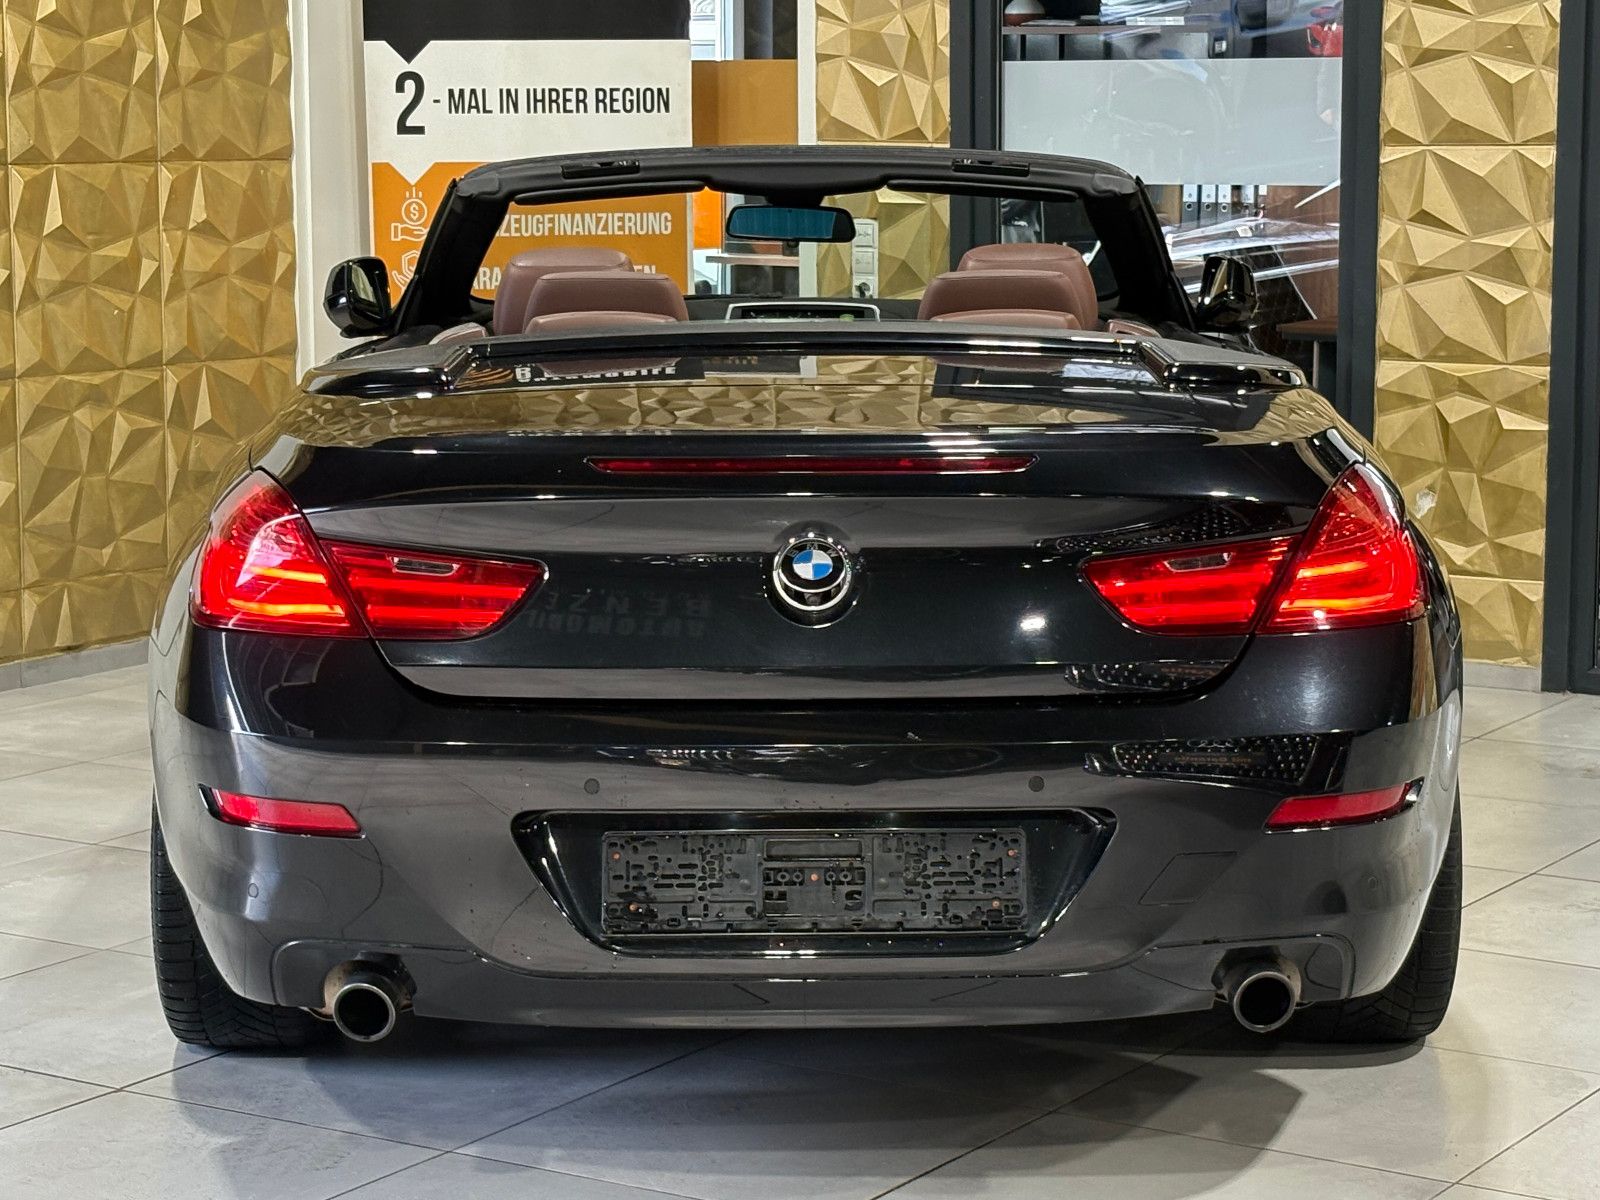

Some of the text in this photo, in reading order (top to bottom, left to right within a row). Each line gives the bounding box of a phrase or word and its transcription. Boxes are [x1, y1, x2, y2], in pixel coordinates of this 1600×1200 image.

[395, 70, 426, 135] 2
[447, 87, 494, 115] MAL
[499, 87, 519, 114] IN
[526, 87, 589, 114] IHRER
[594, 86, 670, 114] REGION
[496, 212, 672, 237] ZEUGFINANZIERUNG
